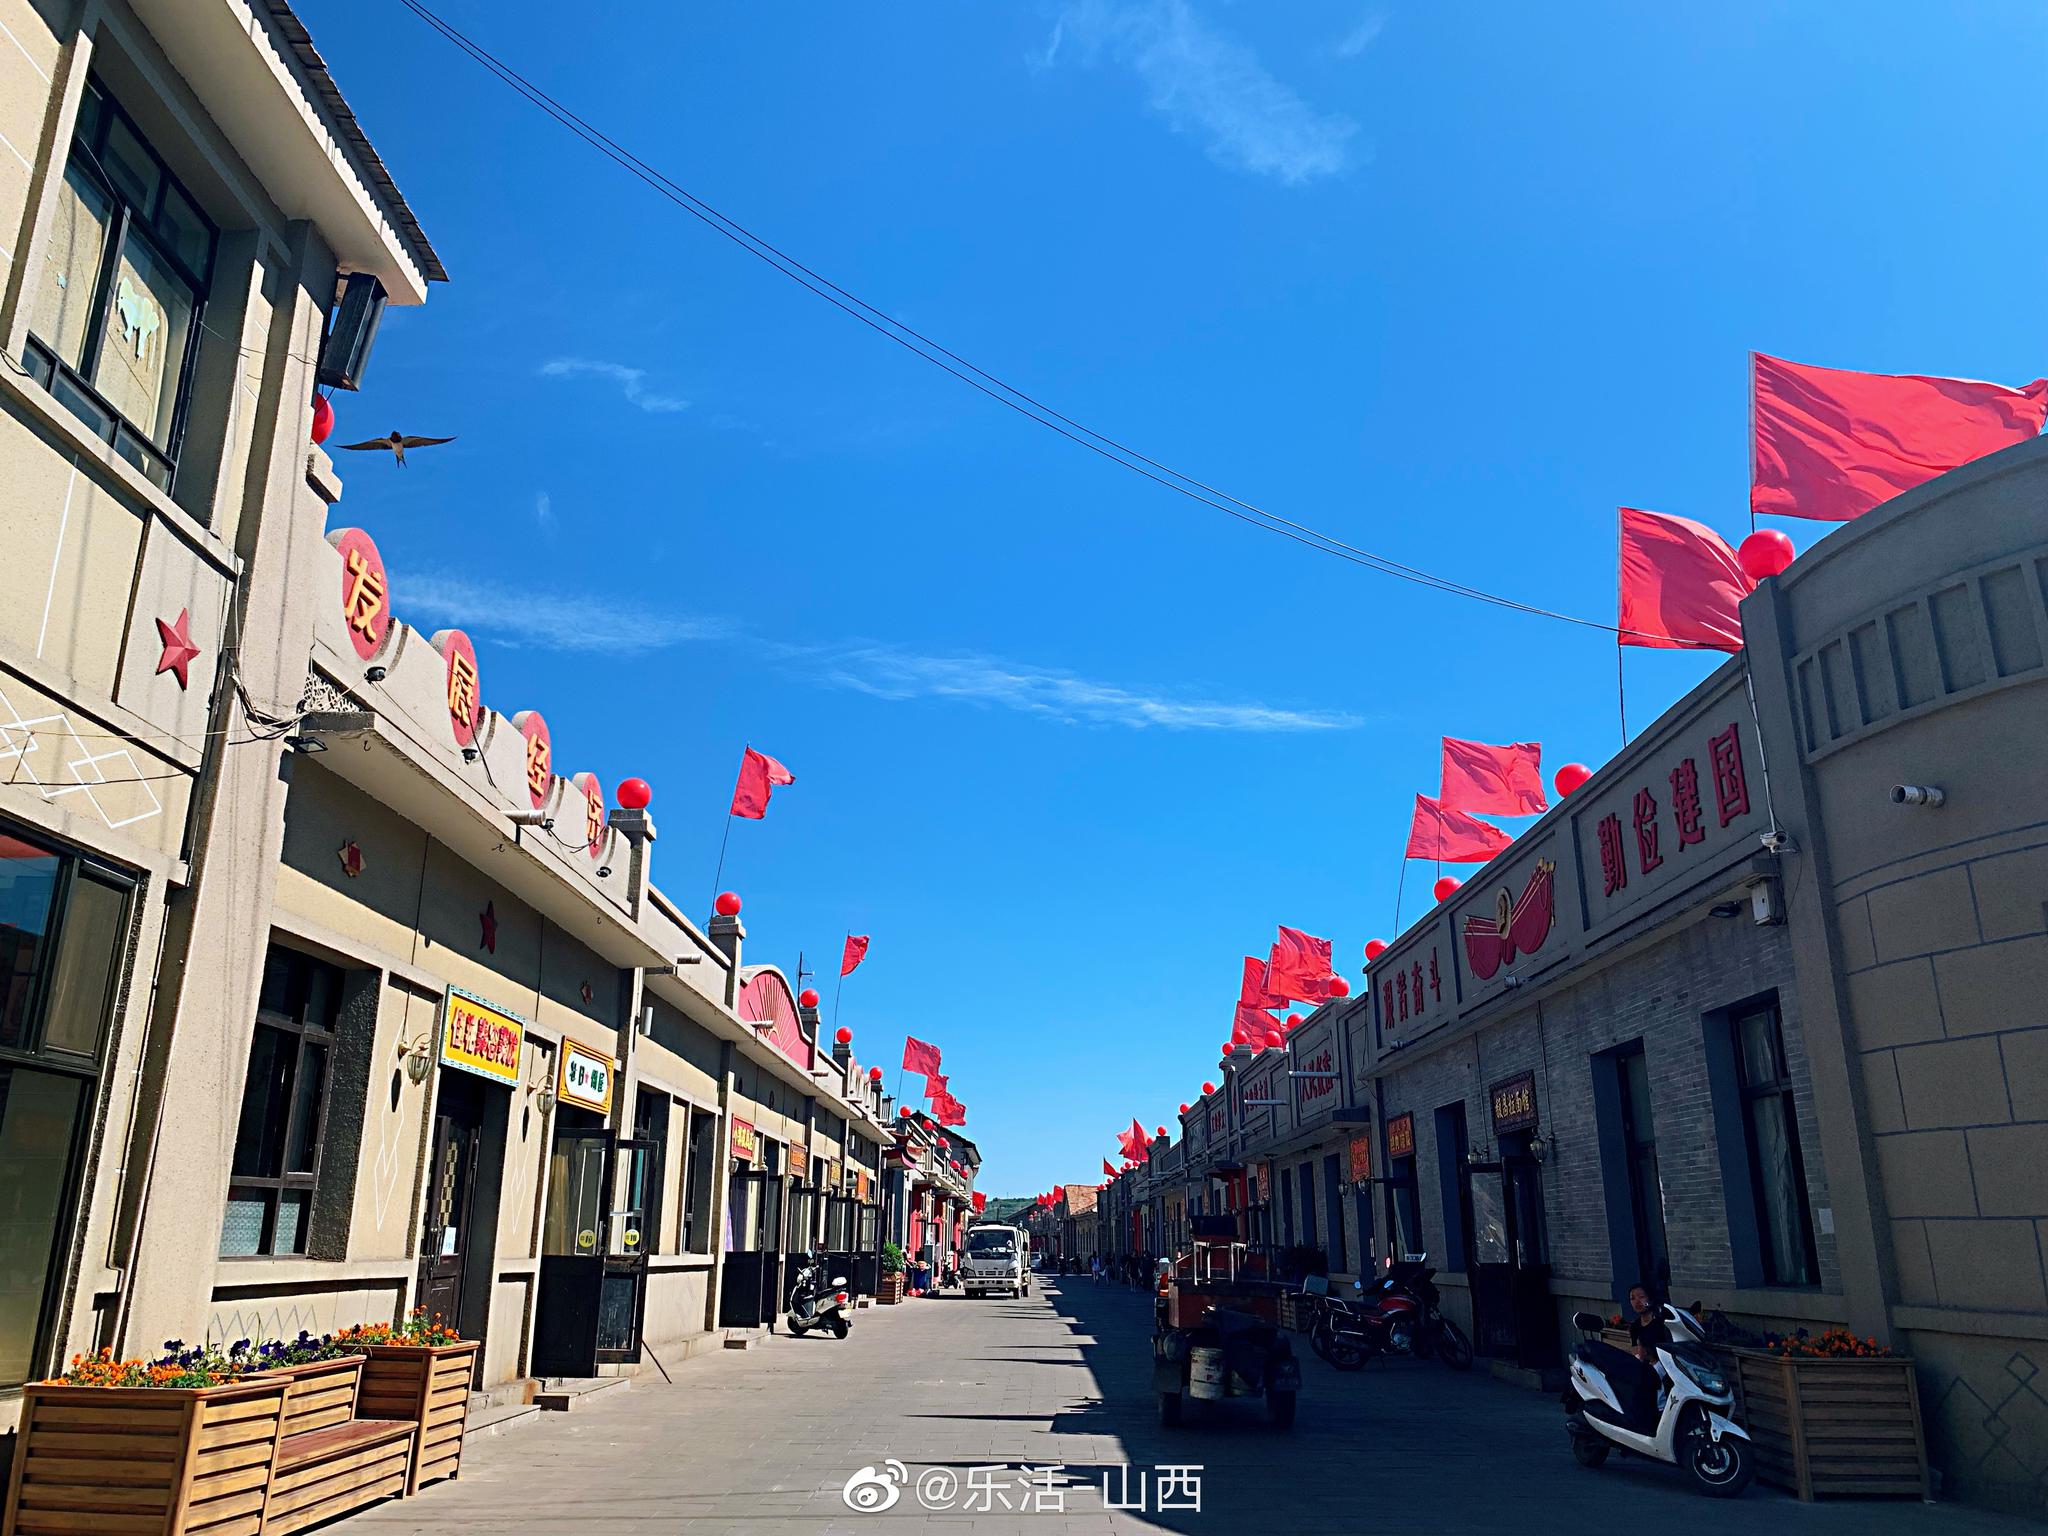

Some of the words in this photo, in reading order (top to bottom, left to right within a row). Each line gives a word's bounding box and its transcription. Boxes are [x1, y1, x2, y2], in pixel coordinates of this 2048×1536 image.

[1597, 722, 1751, 898] 勤俭建国
[1382, 946, 1442, 1030] 艰苦奋斗
